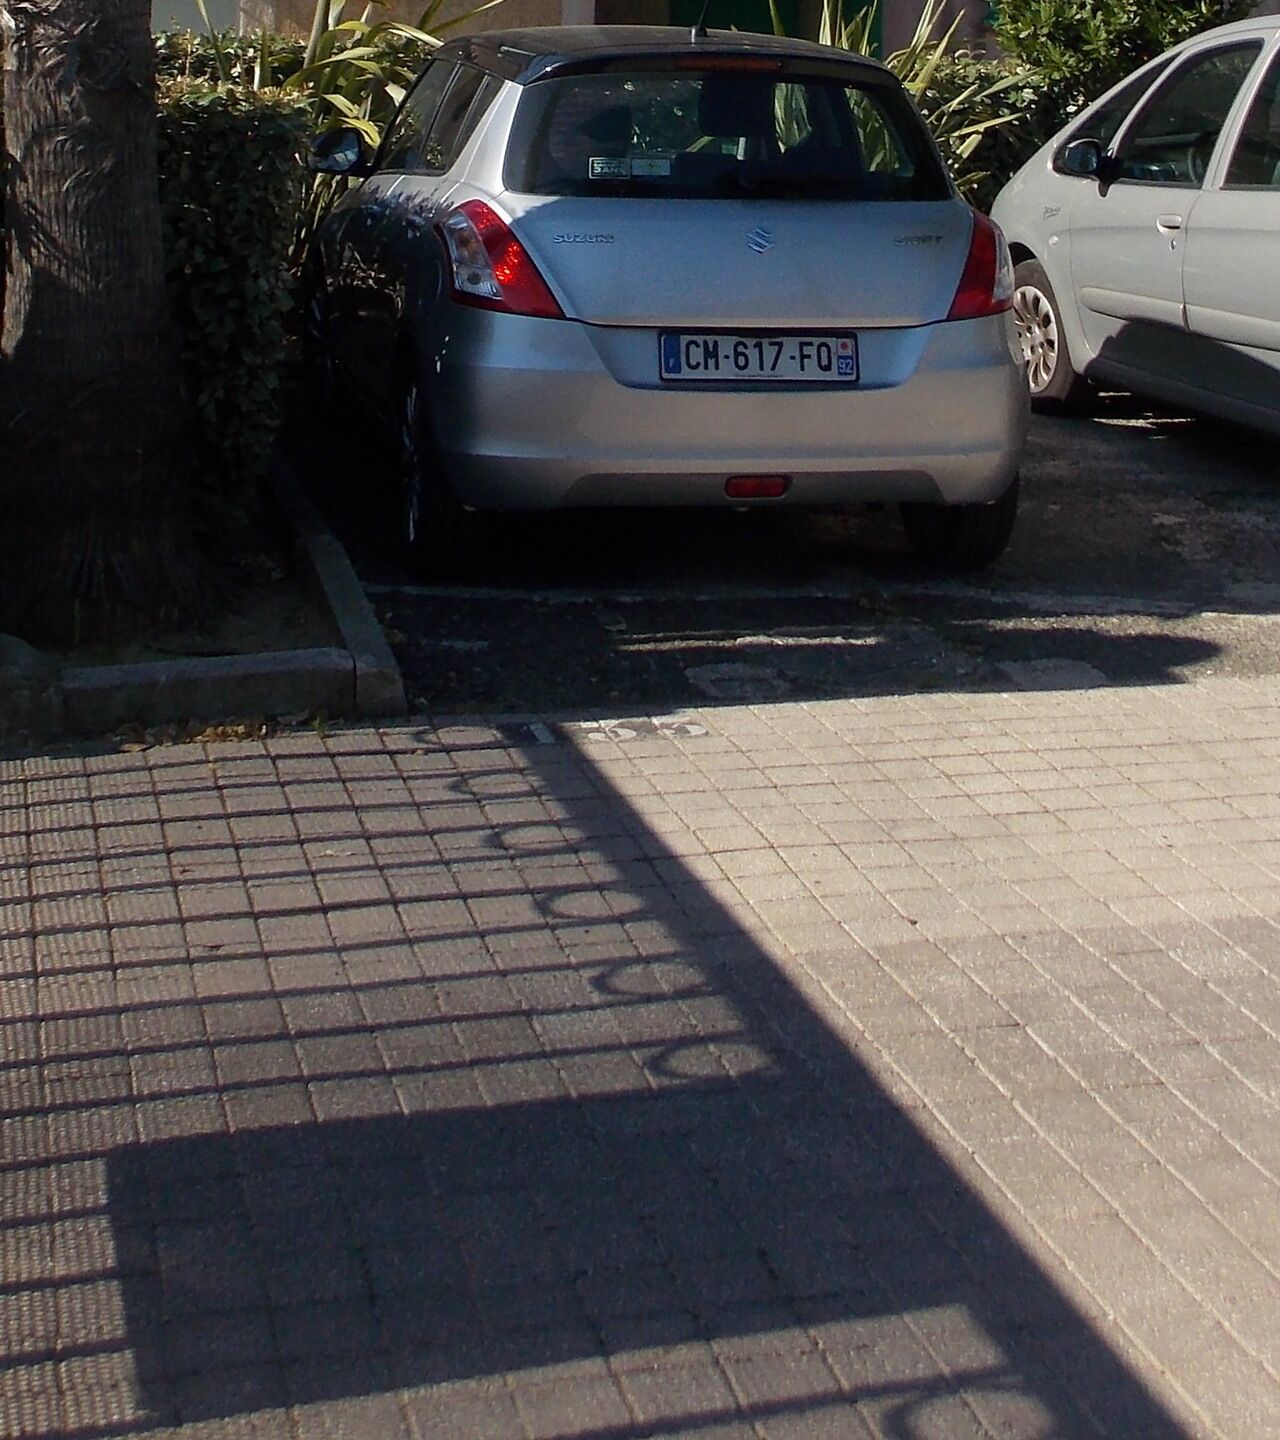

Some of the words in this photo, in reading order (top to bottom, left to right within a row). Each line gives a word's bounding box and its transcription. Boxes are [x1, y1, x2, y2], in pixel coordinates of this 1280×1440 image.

[553, 233, 614, 245] SUZUKI
[684, 339, 832, 372] CM-617-FQ
[838, 358, 853, 373] 92
